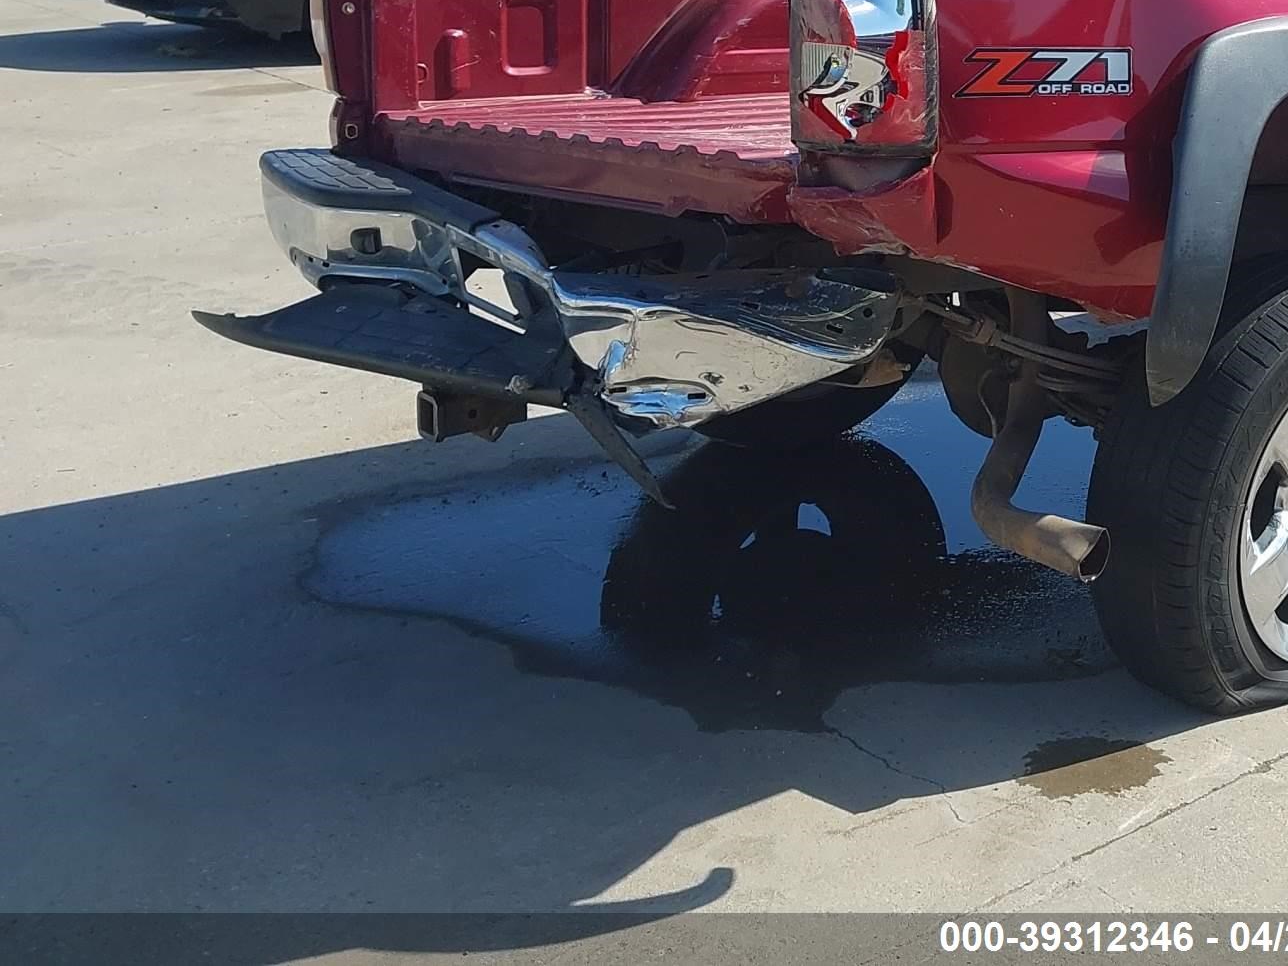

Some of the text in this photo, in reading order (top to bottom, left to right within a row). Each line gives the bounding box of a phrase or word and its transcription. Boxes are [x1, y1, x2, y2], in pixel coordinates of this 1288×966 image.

[963, 51, 1130, 95] Z71
[1037, 83, 1130, 95] OFF ROAD
